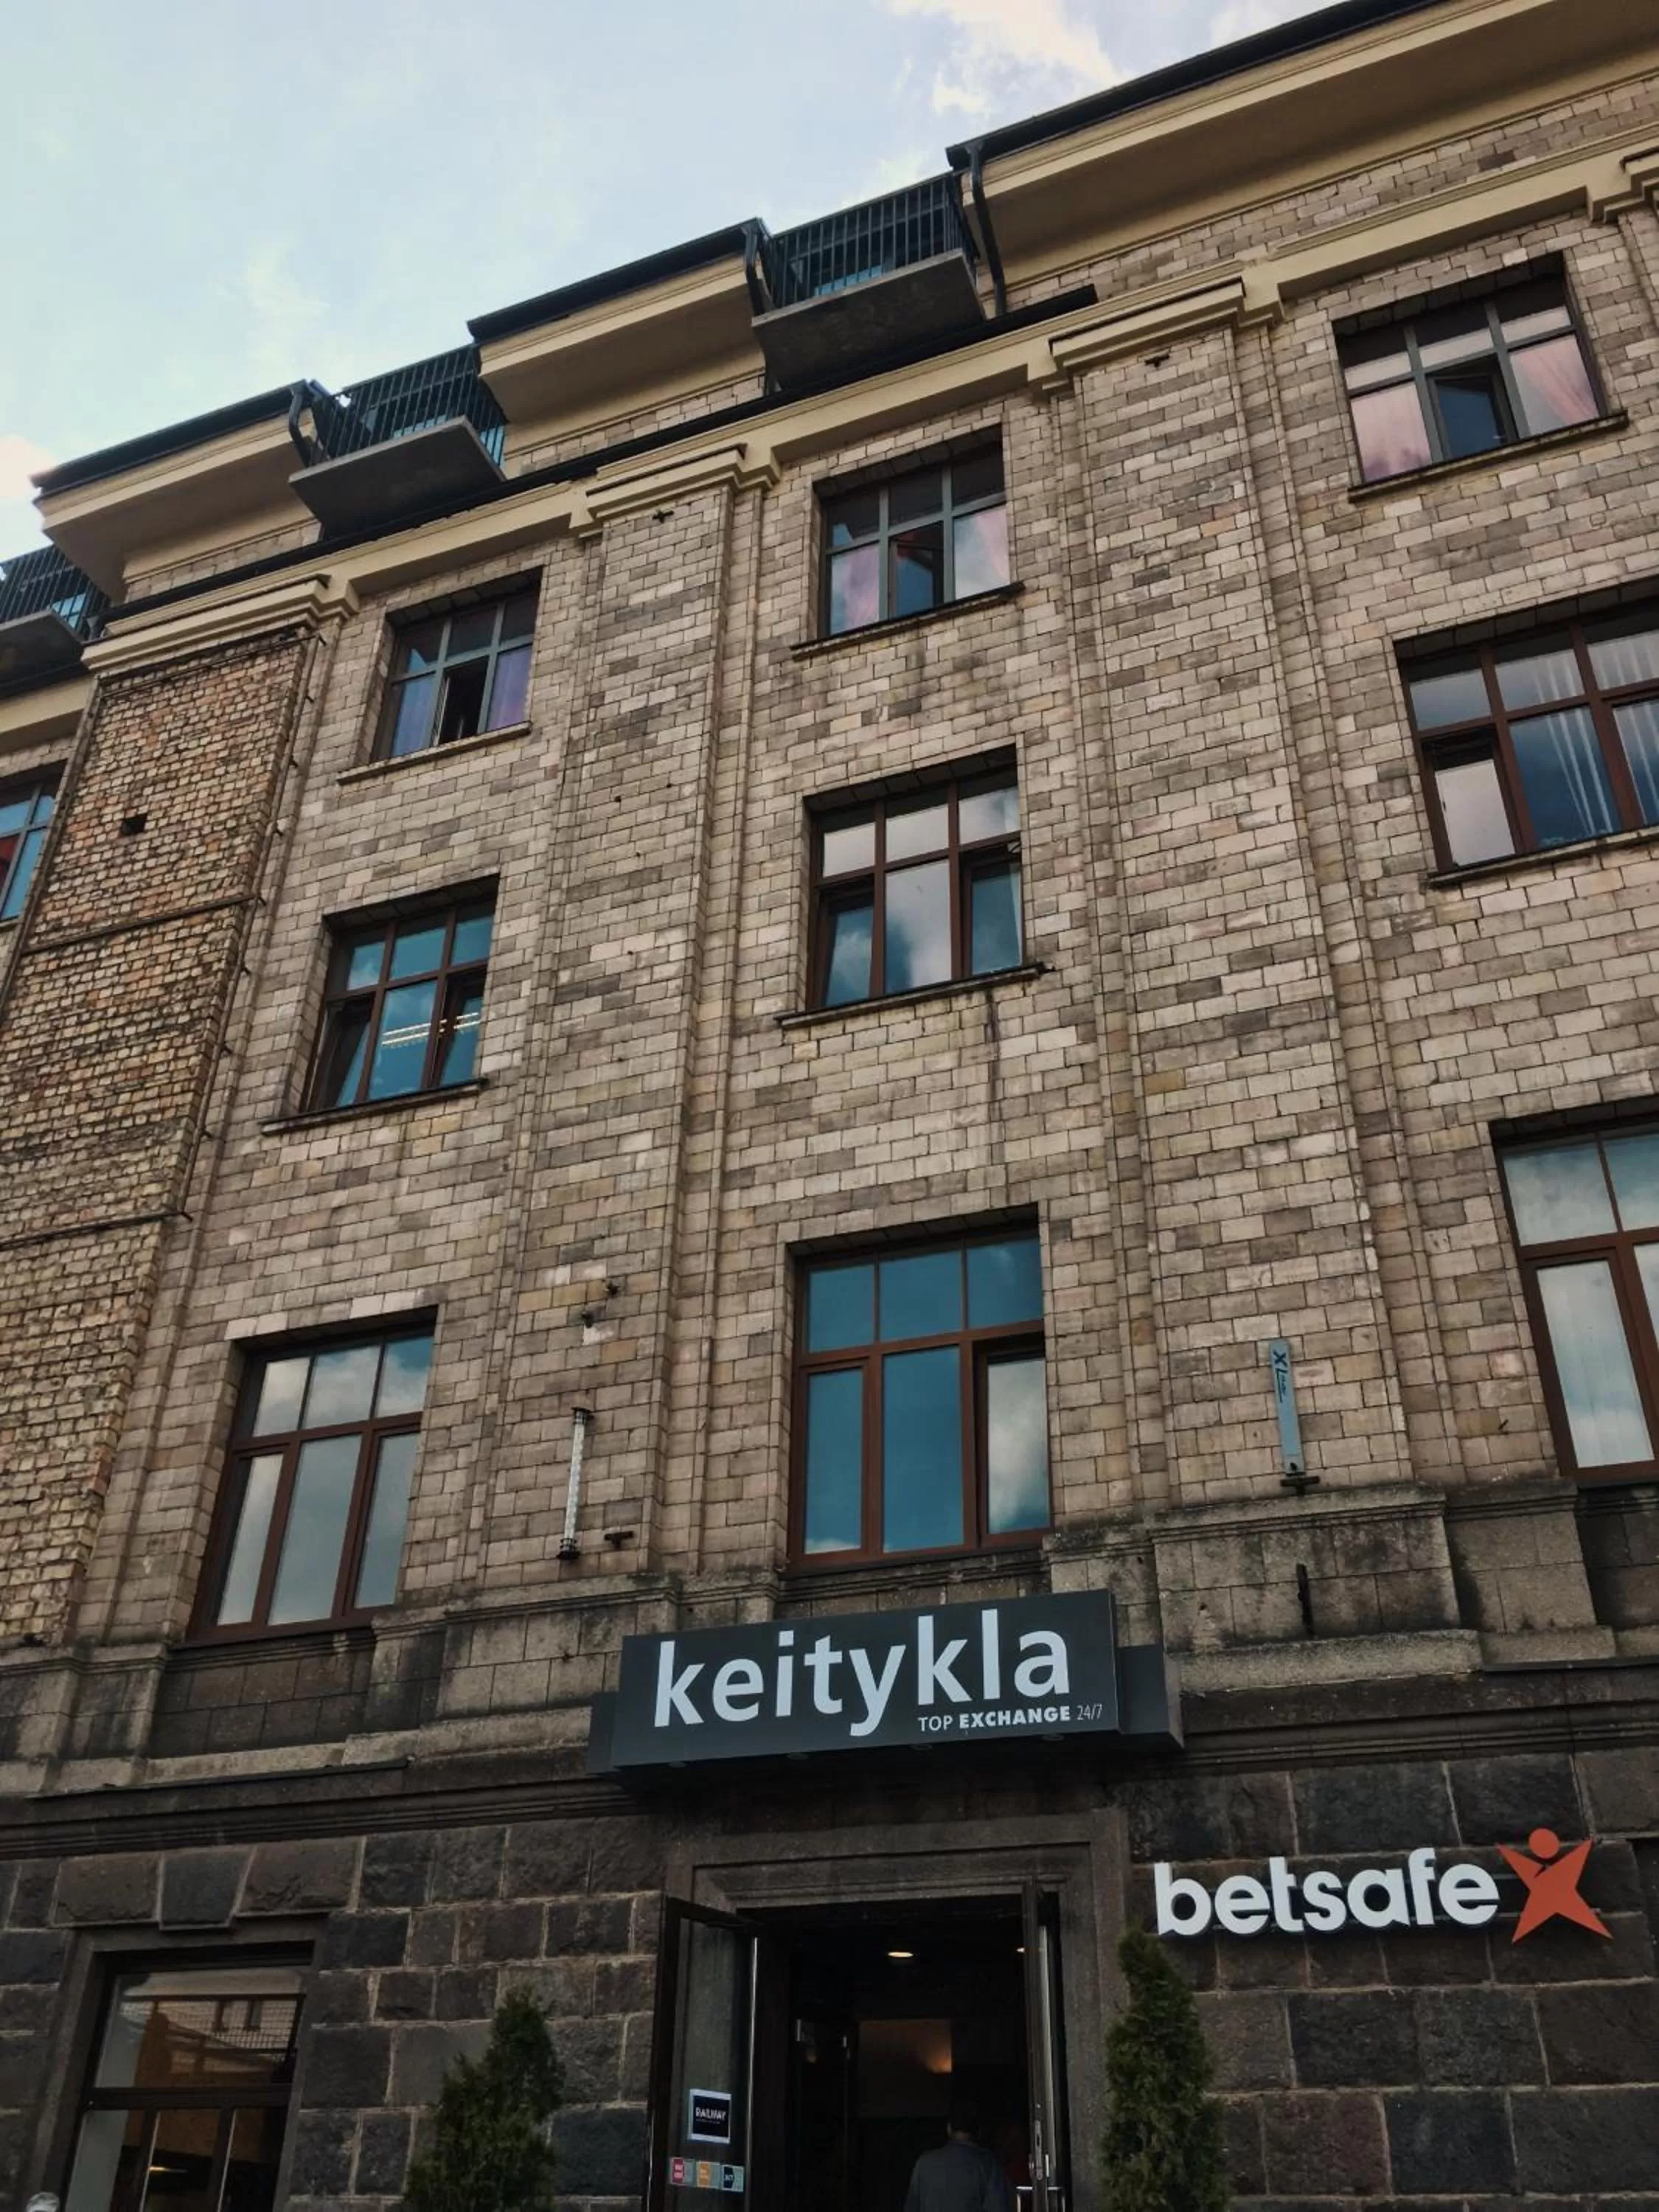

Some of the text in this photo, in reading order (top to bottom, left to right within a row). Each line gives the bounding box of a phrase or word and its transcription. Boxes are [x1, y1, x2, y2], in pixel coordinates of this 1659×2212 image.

[654, 1608, 1071, 1736] keitykla
[917, 1703, 1103, 1732] TOP EXCHANGE 24/7
[1154, 1848, 1499, 1935] betsafe
